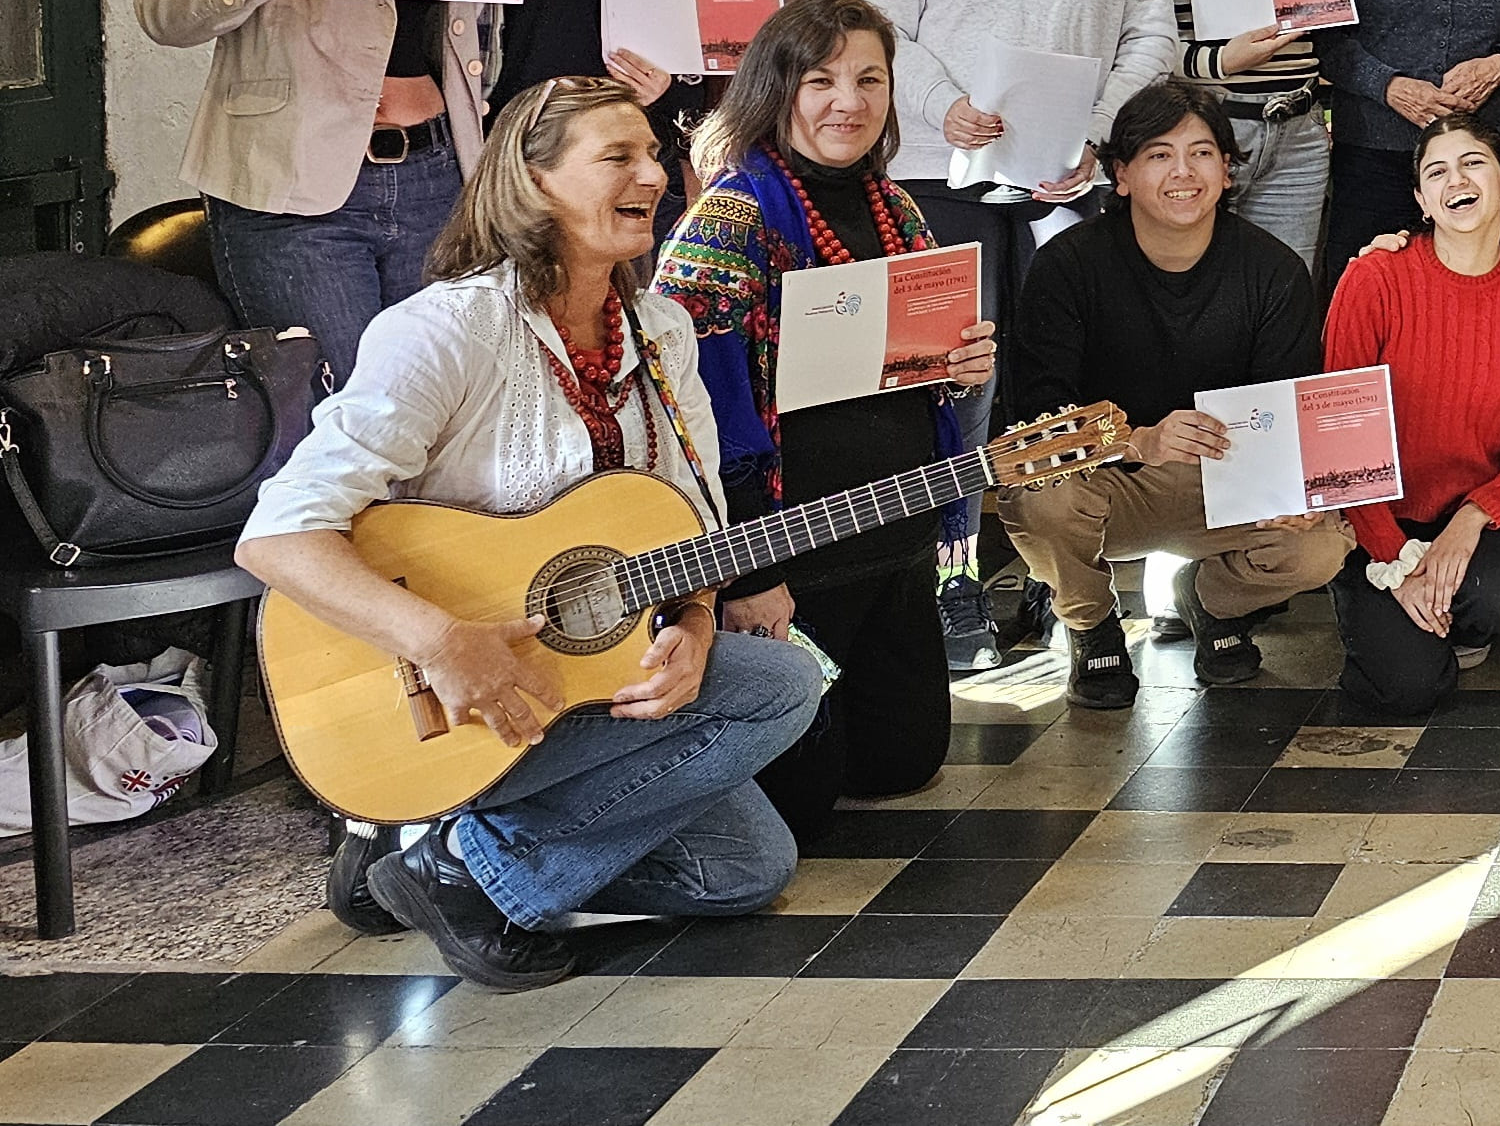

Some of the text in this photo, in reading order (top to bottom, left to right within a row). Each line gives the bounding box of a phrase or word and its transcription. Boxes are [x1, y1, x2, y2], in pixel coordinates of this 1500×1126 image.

[893, 275, 903, 283] La
[893, 285, 906, 294] del
[913, 283, 922, 291] de
[924, 280, 944, 289] mayo
[1301, 394, 1311, 402] La
[1302, 403, 1314, 412] del
[1322, 401, 1331, 409] de
[1333, 400, 1354, 408] mayo
[1087, 655, 1120, 671] PUMA
